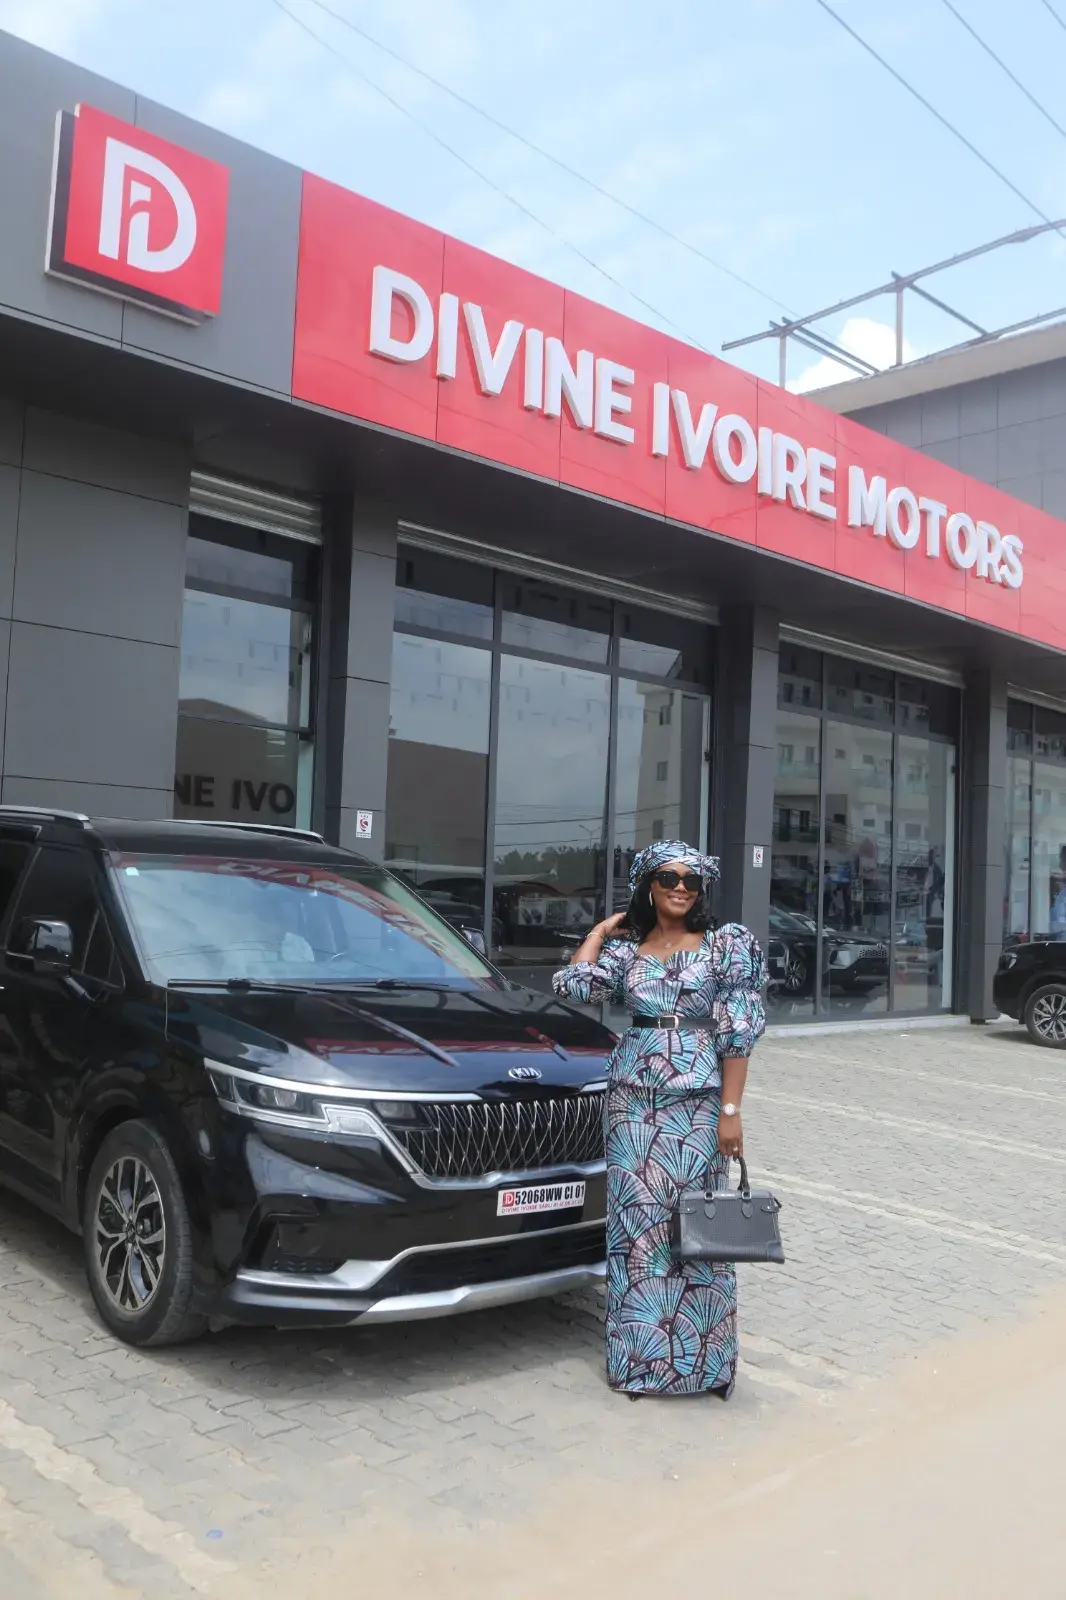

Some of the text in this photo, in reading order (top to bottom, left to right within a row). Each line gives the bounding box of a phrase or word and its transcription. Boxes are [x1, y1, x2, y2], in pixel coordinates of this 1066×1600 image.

[368, 264, 1024, 590] DIVINE IVOIRE MOTORS
[231, 778, 295, 814] IVO
[511, 1067, 540, 1079] KIA
[515, 1186, 562, 1206] 52068WW
[564, 1185, 574, 1200] CI
[575, 1184, 585, 1199] 01
